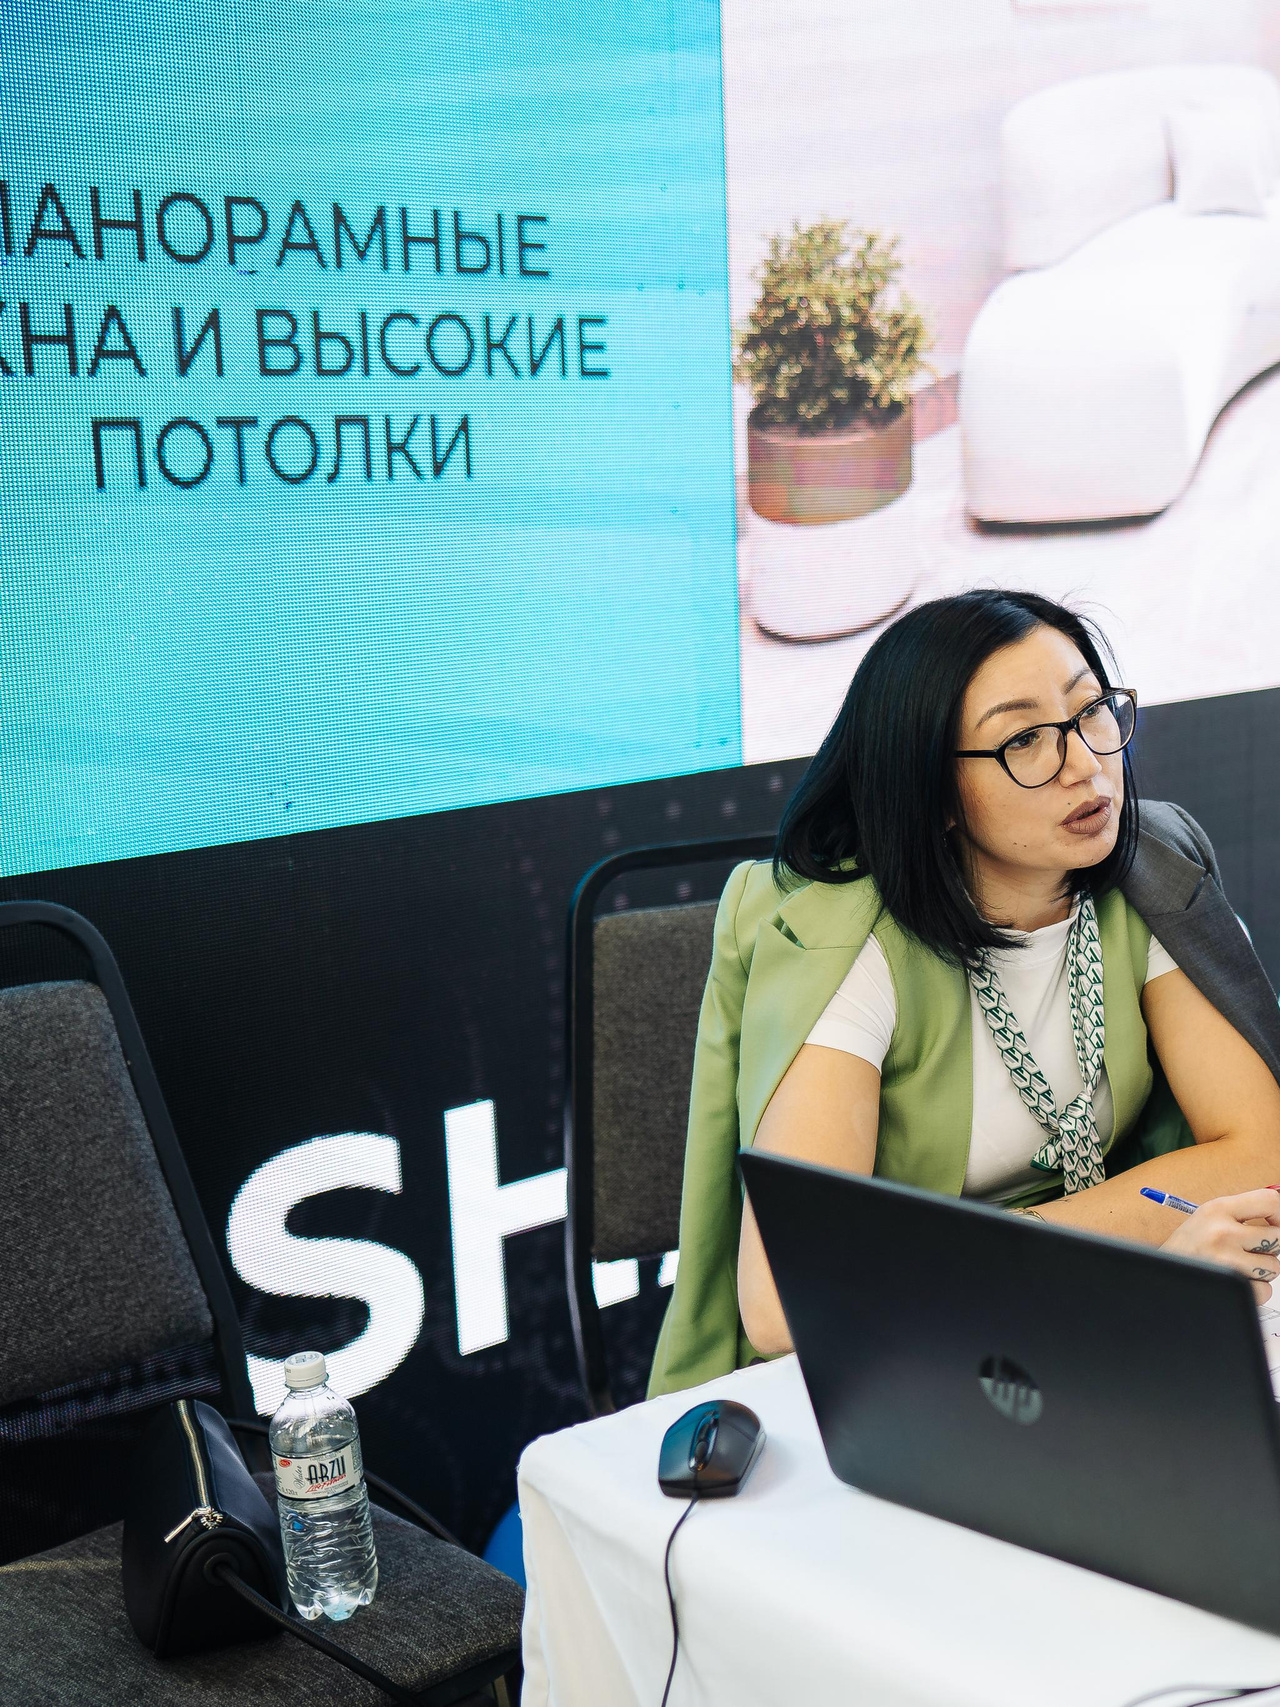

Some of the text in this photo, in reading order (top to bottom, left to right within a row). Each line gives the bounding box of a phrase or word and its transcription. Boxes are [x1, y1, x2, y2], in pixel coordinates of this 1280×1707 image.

[0, 300, 610, 378] НА И ВЫСОКИЕ
[91, 413, 472, 489] ПОТОЛКИ
[305, 1455, 347, 1485] ARZU
